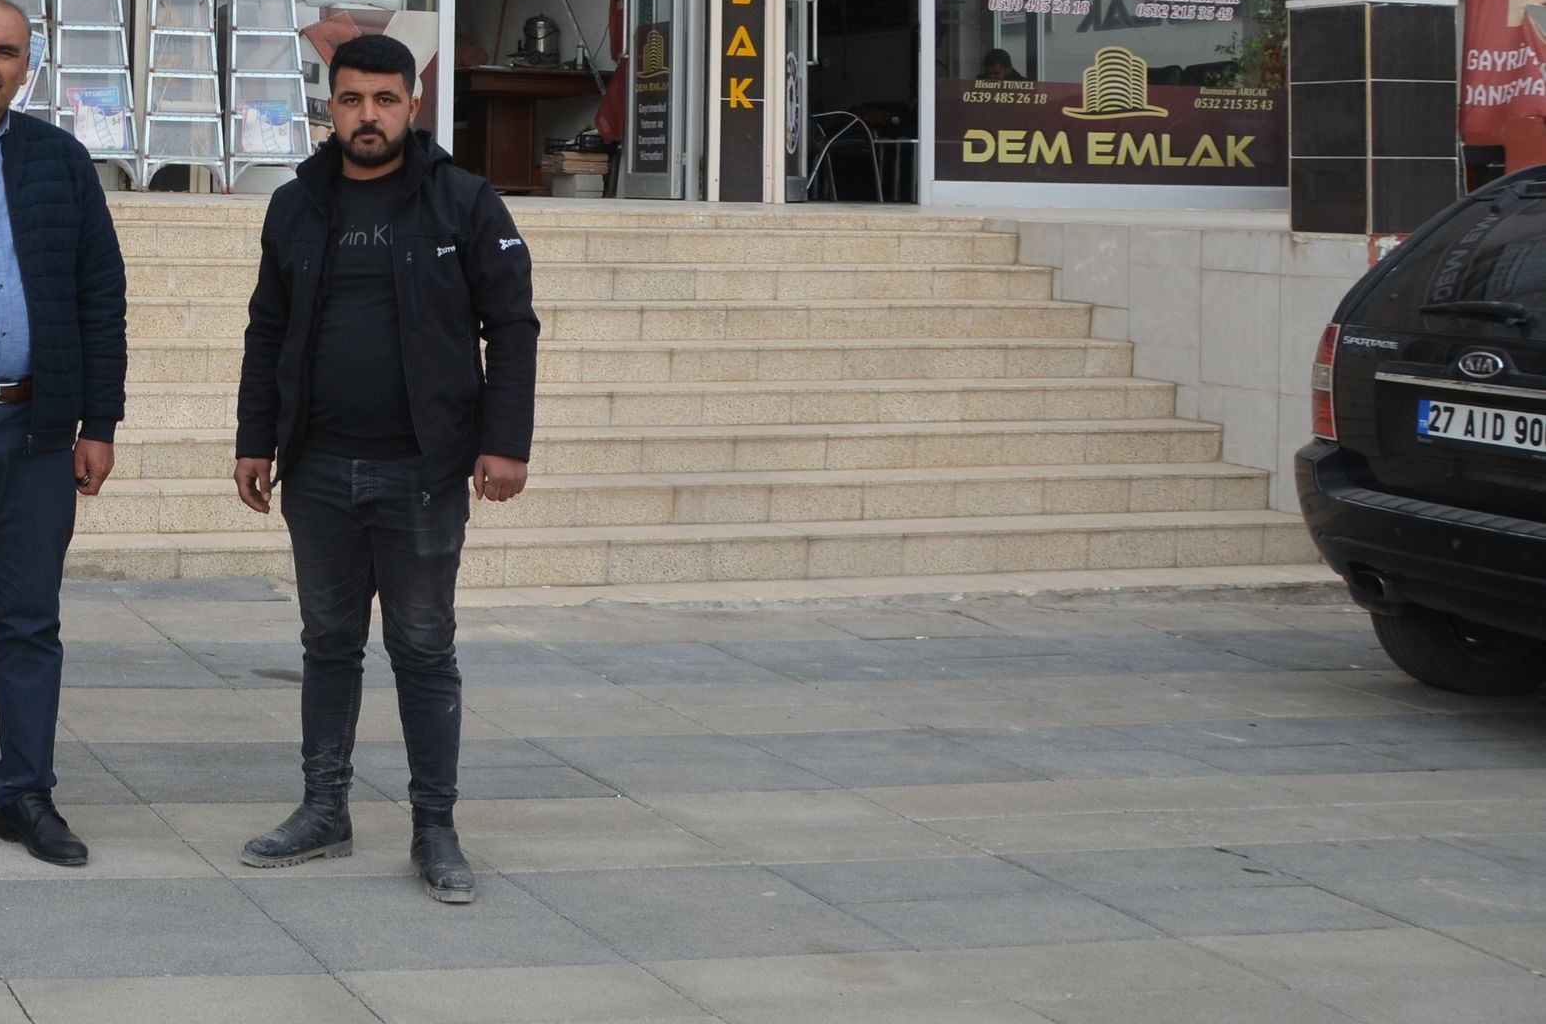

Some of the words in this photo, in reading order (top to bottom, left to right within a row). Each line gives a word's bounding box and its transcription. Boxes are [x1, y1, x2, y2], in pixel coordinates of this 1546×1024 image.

[1051, 0, 1071, 14] 26
[1072, 0, 1091, 15] 18
[1136, 3, 1170, 18] 0532
[1170, 4, 1196, 19] 215
[1197, 5, 1215, 20] 35
[1215, 7, 1234, 21] 43
[1467, 43, 1546, 76] GAYRİM
[974, 79, 1001, 89] Hisari
[1003, 80, 1035, 90] TUNCEL
[962, 91, 991, 103] 0539
[993, 92, 1015, 104] 485
[1016, 92, 1031, 104] 26
[1034, 93, 1048, 105] 18
[1194, 97, 1221, 109] 0532
[1222, 98, 1243, 110] 215
[1244, 99, 1258, 110] 35
[1260, 99, 1274, 111] 43
[962, 129, 1073, 166] DEM
[1087, 131, 1256, 169] EMLAK
[1342, 335, 1399, 350] SPORTAGE
[1464, 357, 1494, 373] KIA
[1429, 404, 1456, 434] 27
[1463, 409, 1506, 441] AID
[1514, 415, 1546, 447] 90
